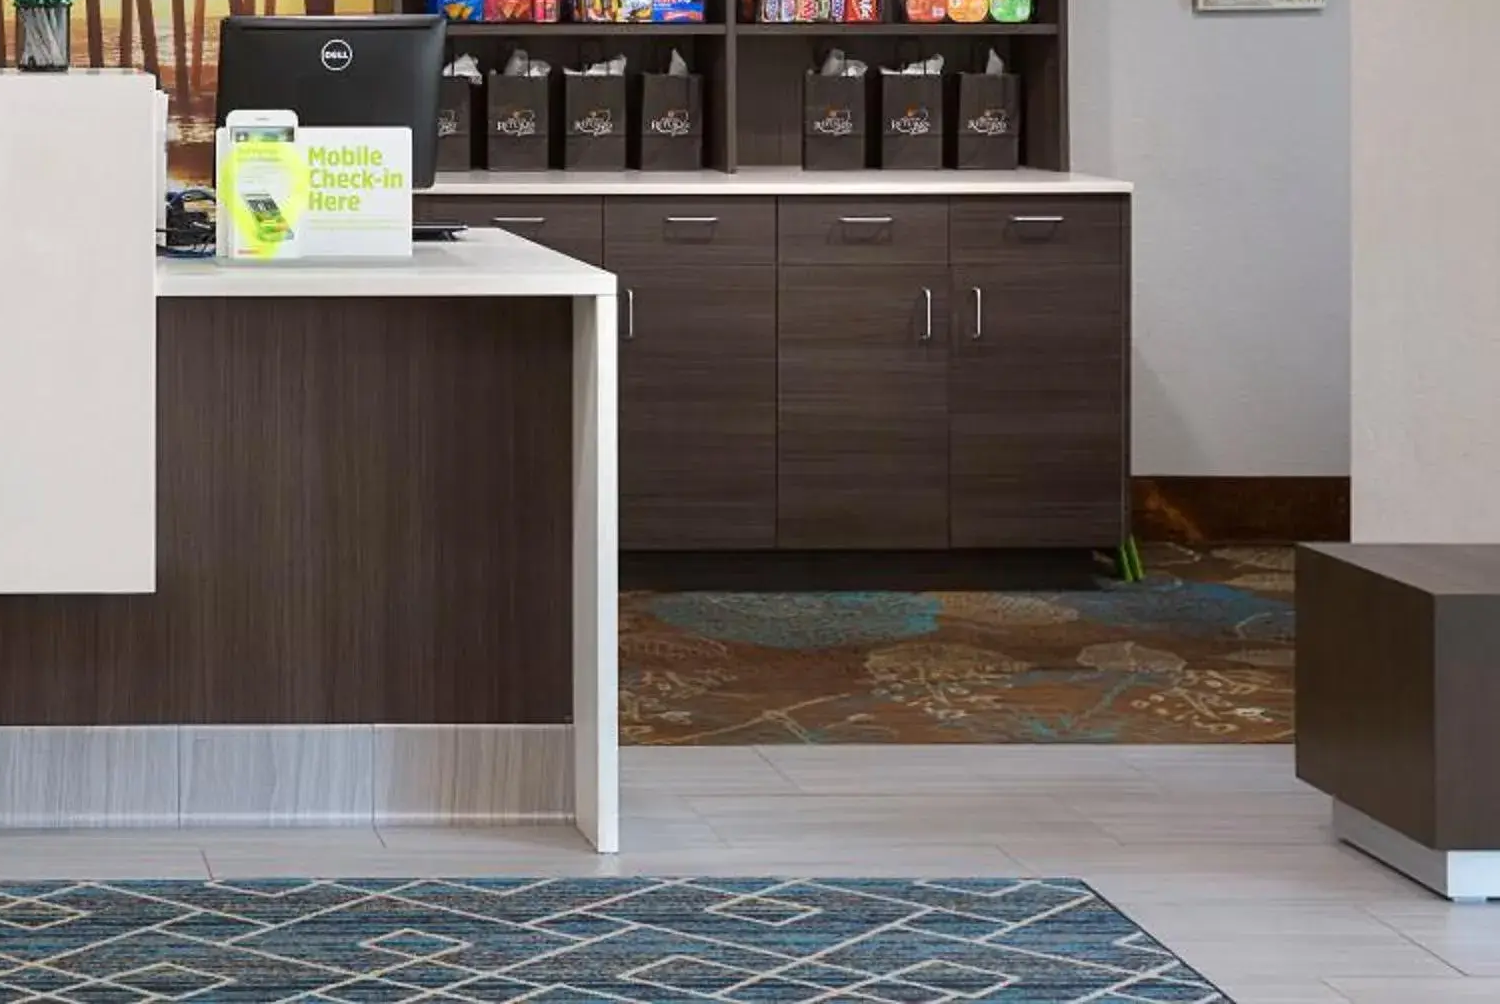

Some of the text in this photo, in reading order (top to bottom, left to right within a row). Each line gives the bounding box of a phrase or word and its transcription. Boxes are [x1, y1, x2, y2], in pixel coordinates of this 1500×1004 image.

[325, 51, 348, 59] DELL
[308, 147, 383, 165] Mobile
[308, 169, 404, 188] Check-in
[308, 192, 361, 211] Here
